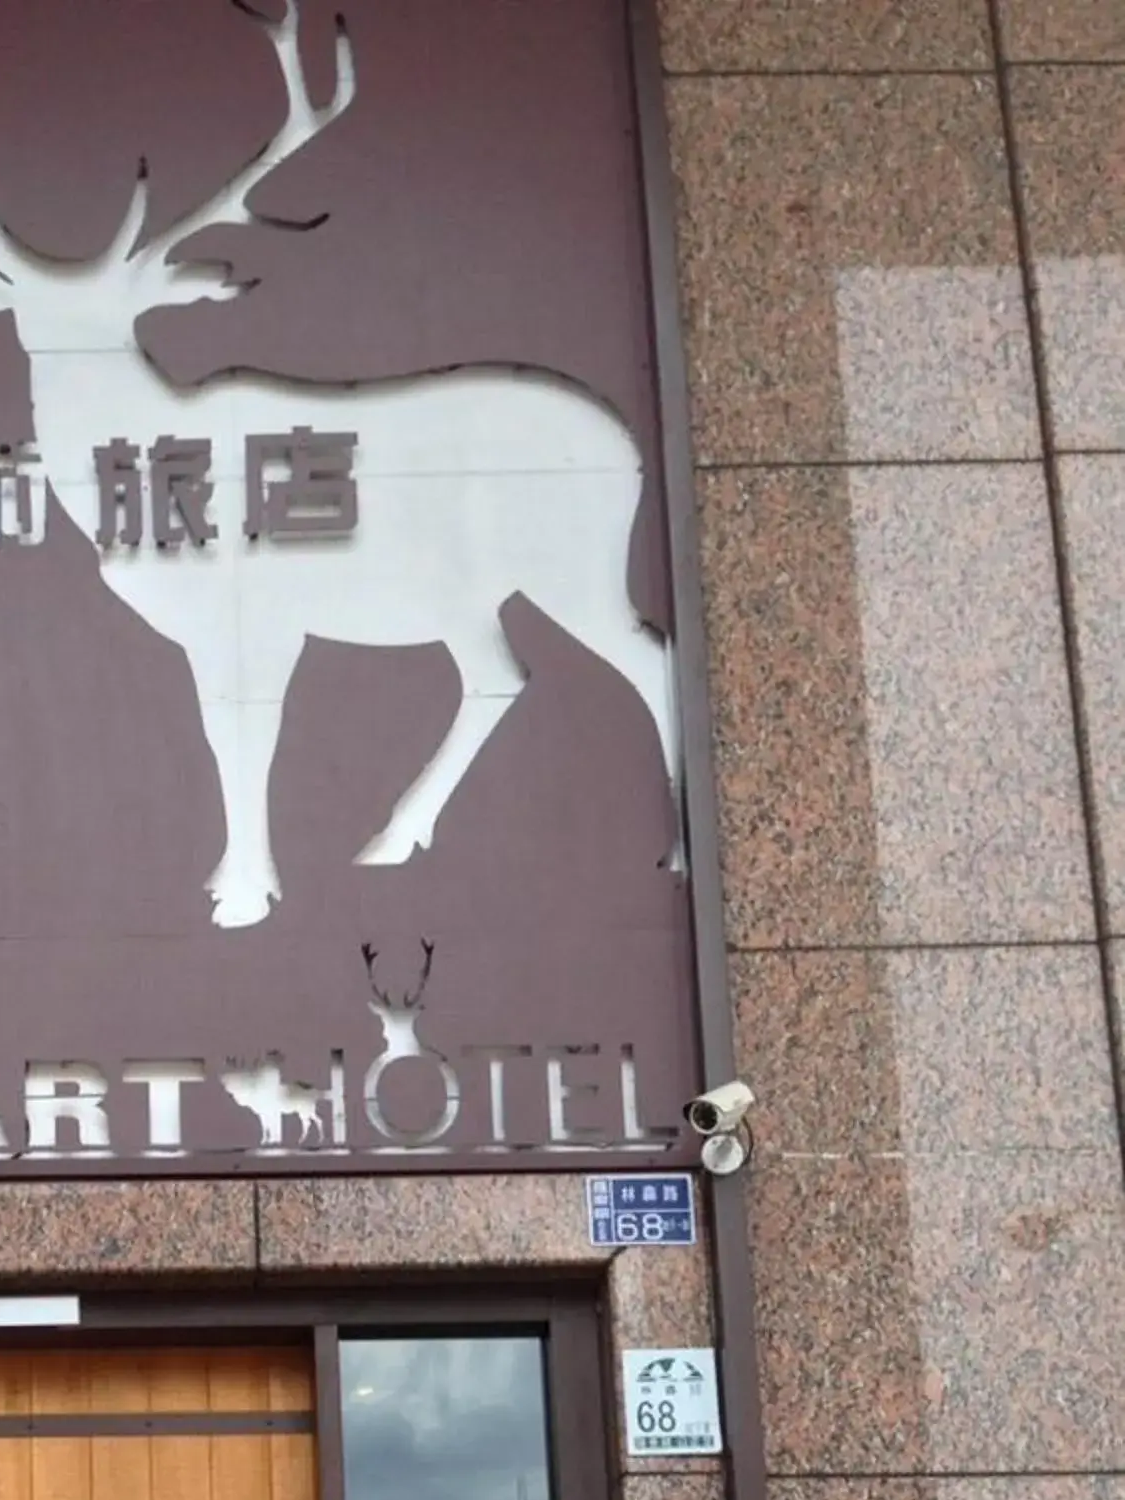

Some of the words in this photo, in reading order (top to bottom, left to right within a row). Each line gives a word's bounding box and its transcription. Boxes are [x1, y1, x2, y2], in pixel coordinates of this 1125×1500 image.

[263, 1044, 679, 1144] HOTEL
[616, 1212, 664, 1241] 68
[636, 1400, 677, 1433] 68
